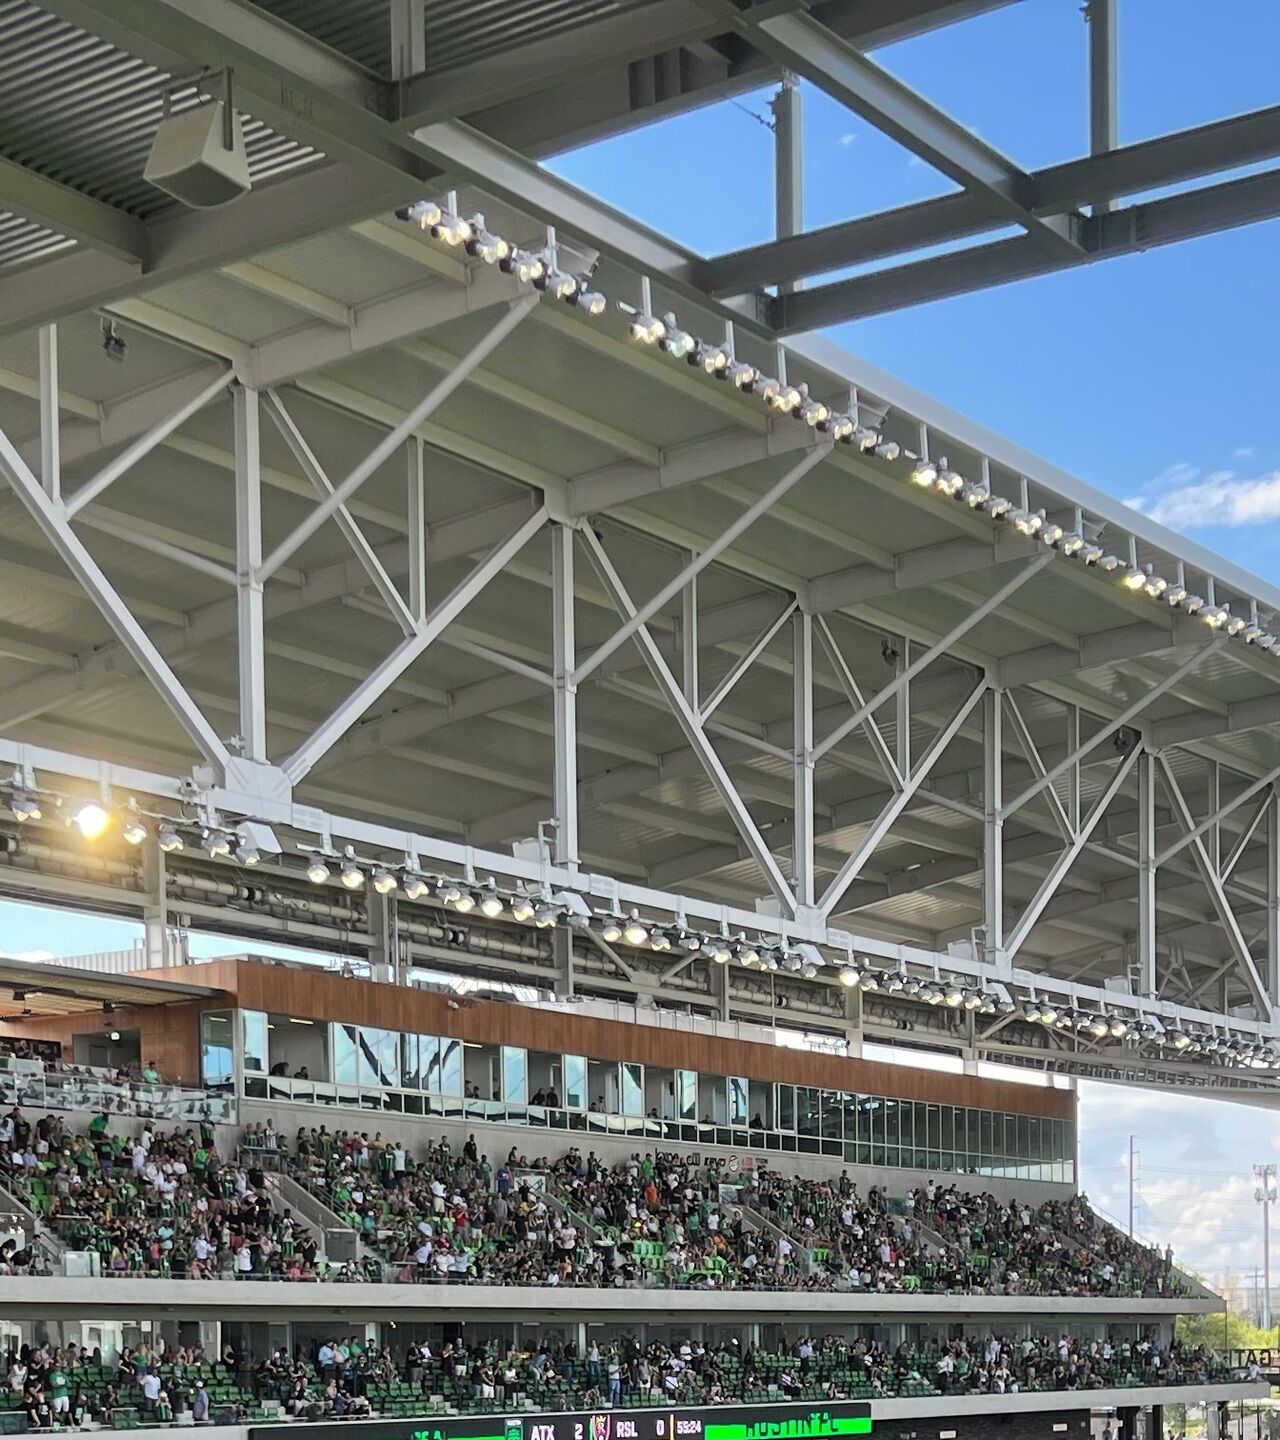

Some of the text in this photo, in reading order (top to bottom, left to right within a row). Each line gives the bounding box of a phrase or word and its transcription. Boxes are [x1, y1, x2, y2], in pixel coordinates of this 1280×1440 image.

[574, 1422, 584, 1440] 2
[616, 1419, 665, 1438] RSL 0
[677, 1420, 702, 1435] 55:24
